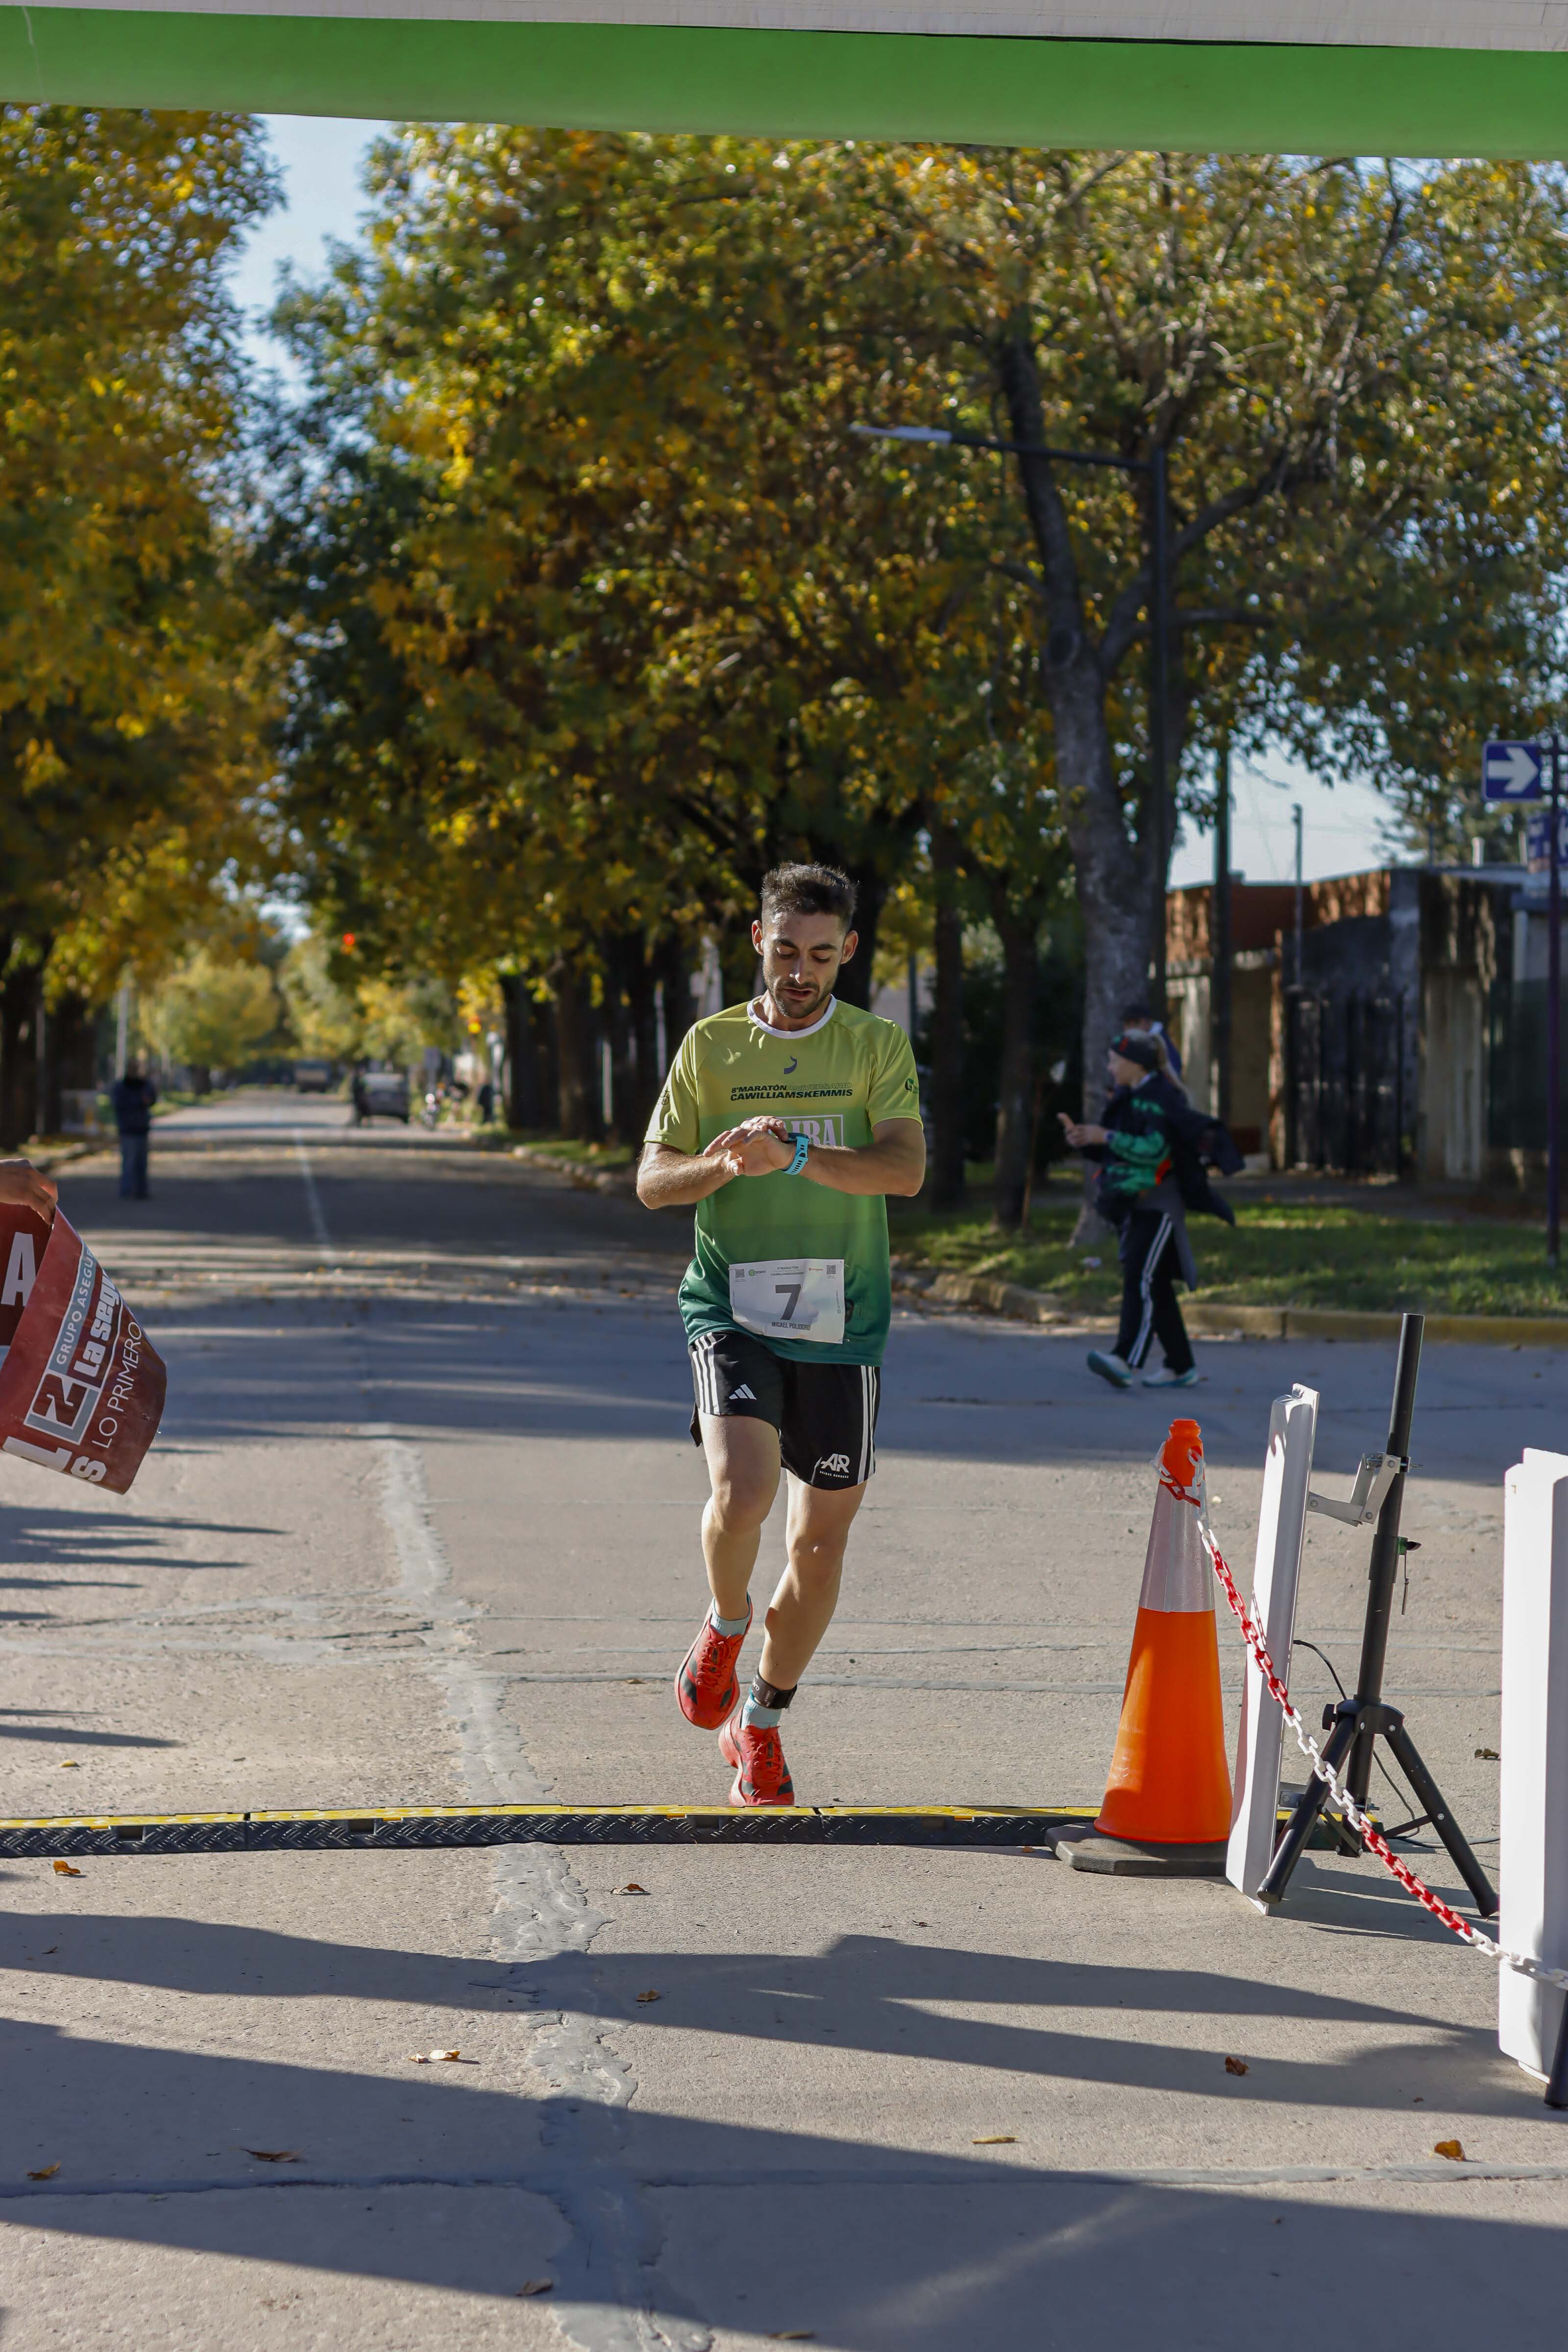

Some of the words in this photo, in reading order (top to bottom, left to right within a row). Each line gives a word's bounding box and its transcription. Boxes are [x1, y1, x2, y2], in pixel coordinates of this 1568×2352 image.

[775, 1284, 802, 1321] 7
[56, 1311, 82, 1365] GRUPO
[74, 1341, 106, 1377] La
[92, 1417, 118, 1448] LO
[107, 1322, 142, 1412] PRIMERO
[820, 1453, 850, 1473] AR
